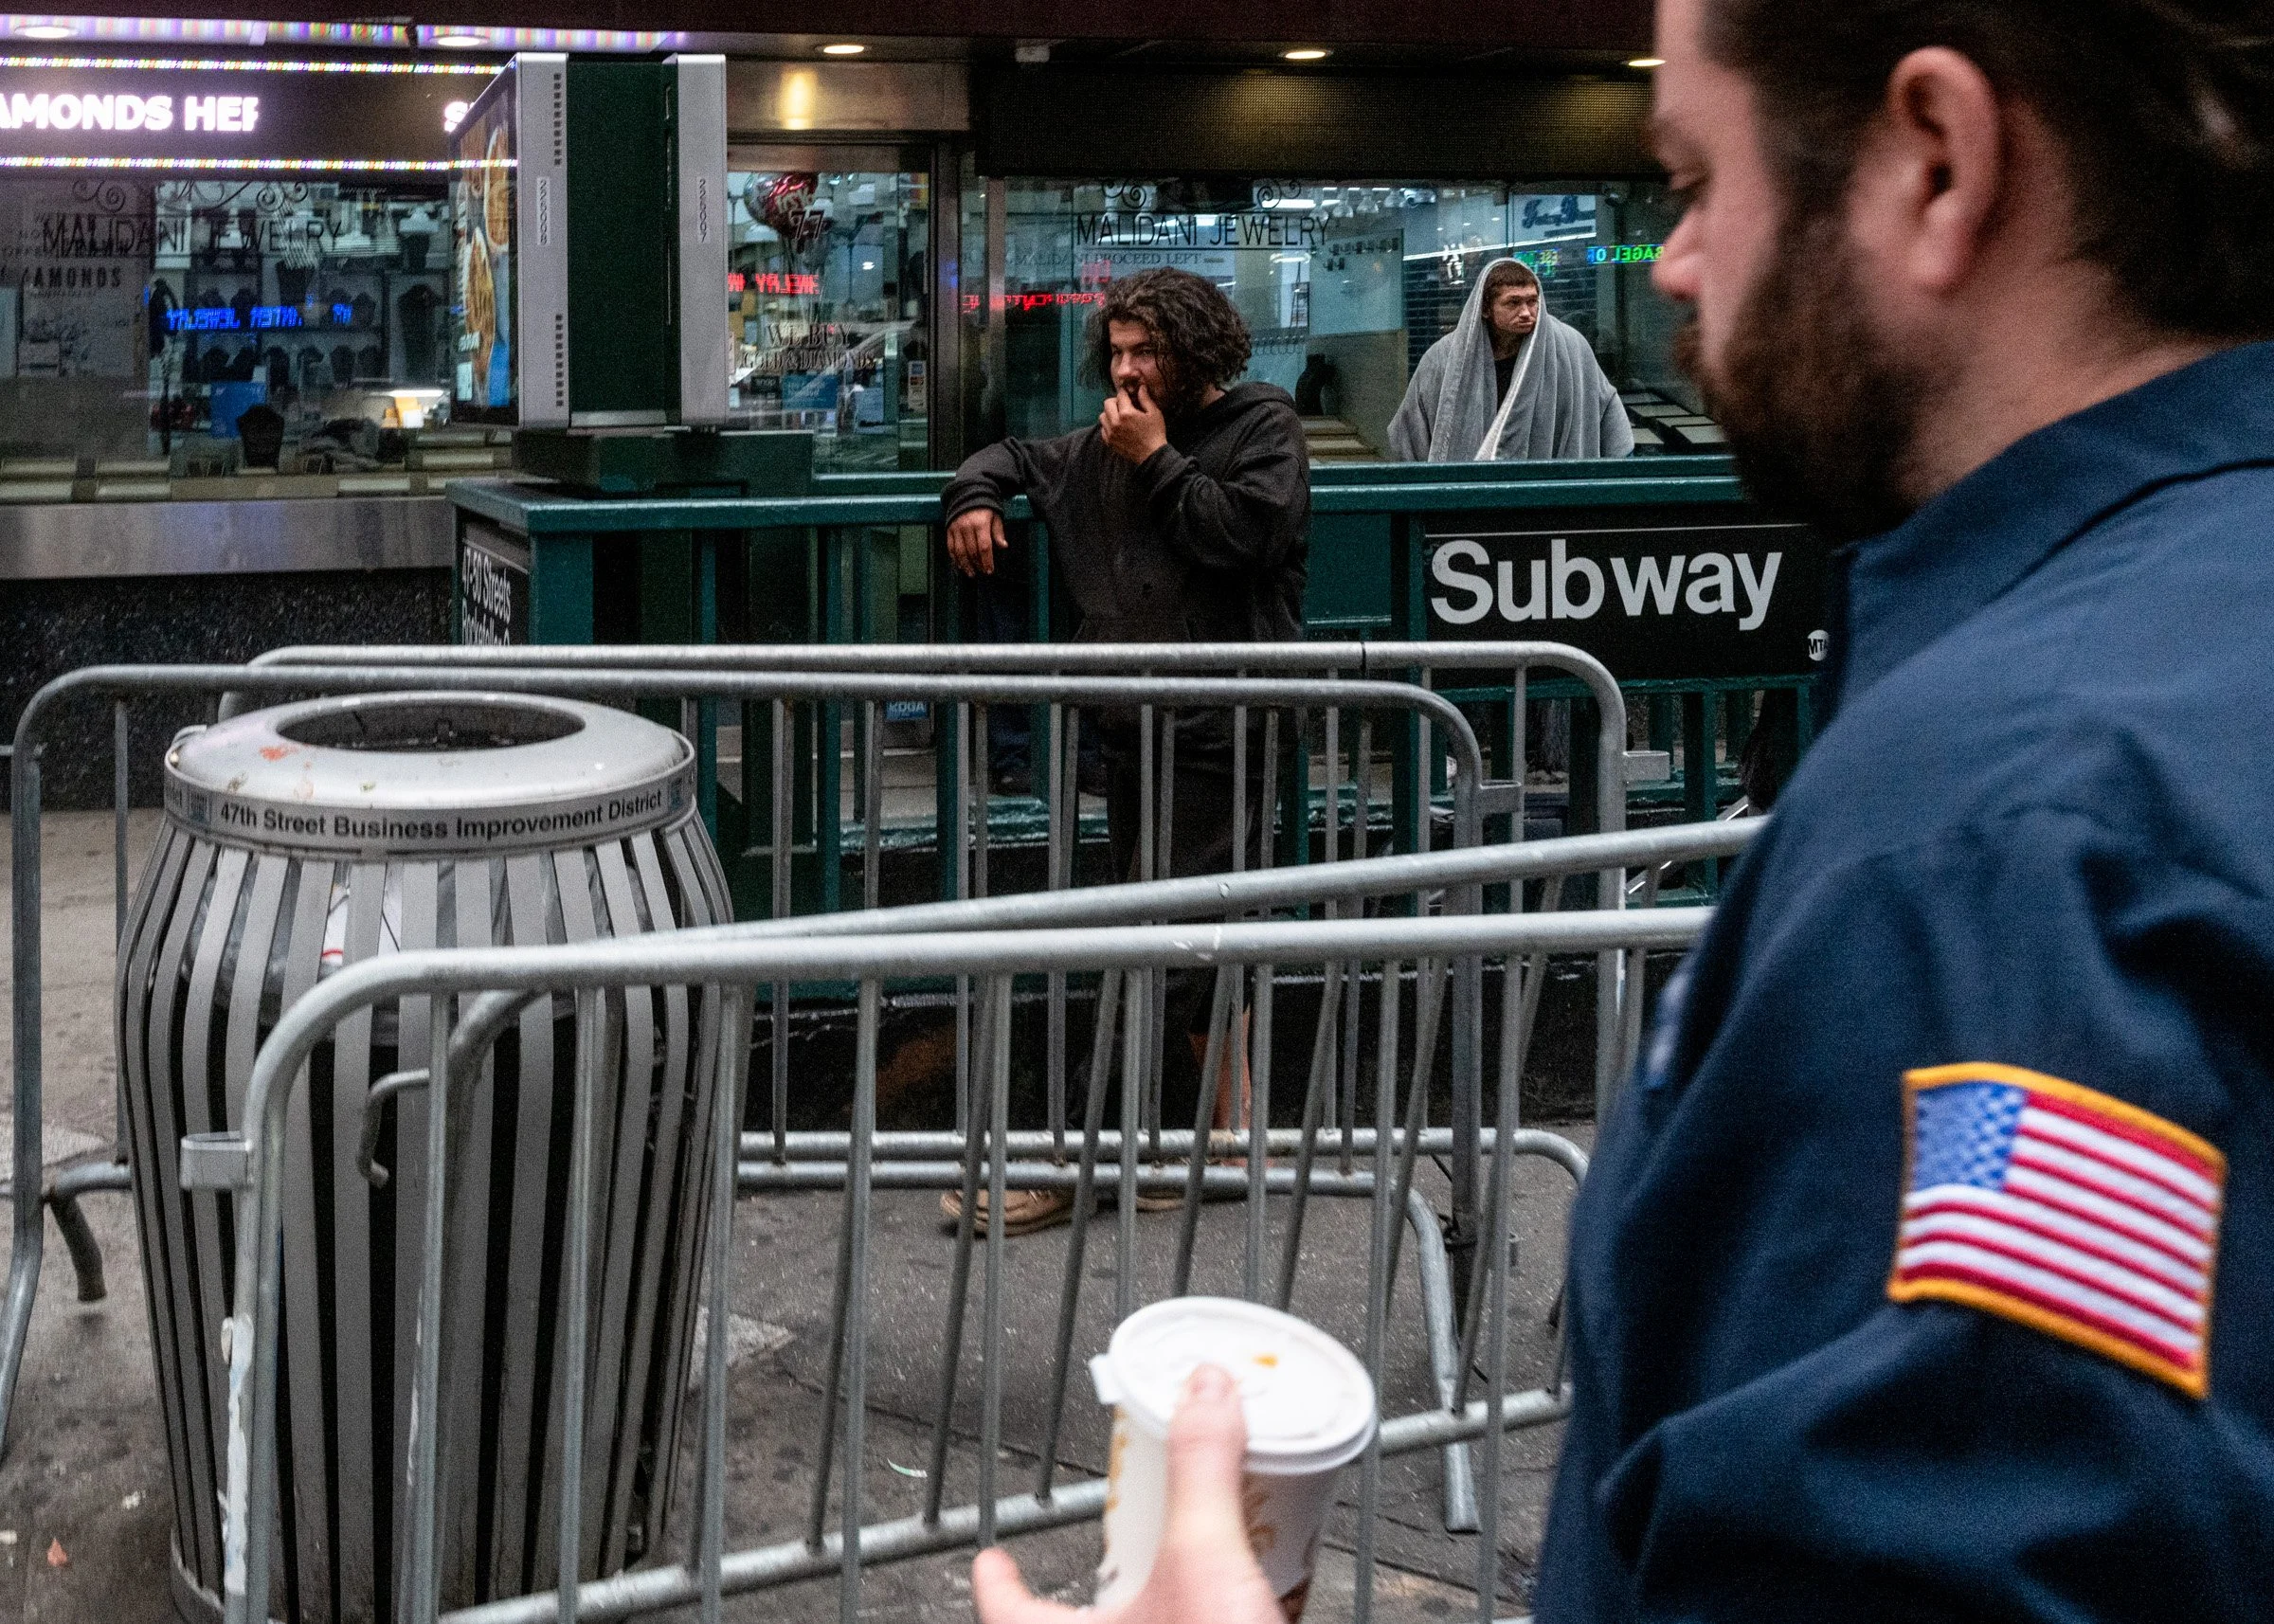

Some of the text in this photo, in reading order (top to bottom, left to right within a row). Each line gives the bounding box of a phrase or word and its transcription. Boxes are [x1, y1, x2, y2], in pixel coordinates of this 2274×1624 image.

[1076, 214, 1329, 247] MALIDANI JEWELRY
[482, 554, 512, 625] Streets
[1431, 538, 1783, 631] Subway
[220, 789, 661, 841] 47th Street Business Improvement District
